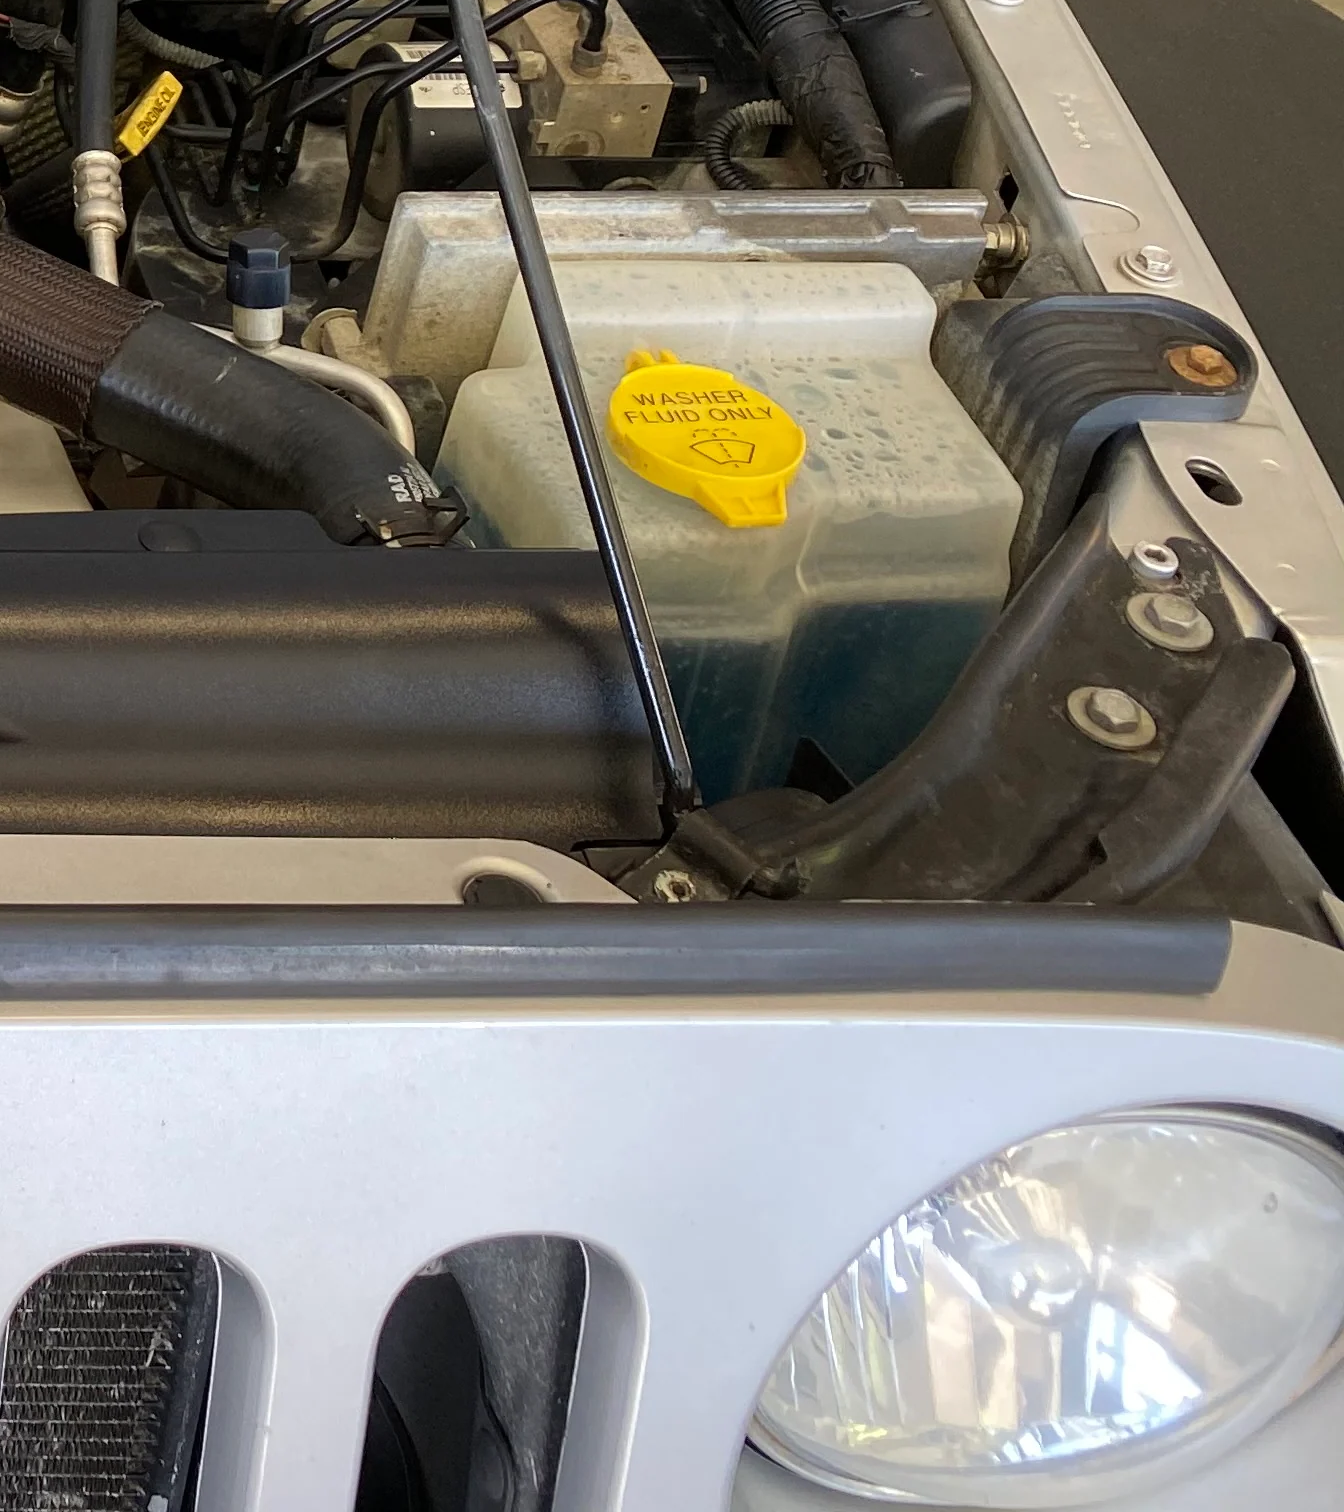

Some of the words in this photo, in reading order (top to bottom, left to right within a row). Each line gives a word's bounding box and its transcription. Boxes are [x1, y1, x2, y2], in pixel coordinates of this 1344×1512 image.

[136, 97, 167, 138] ENGINE
[632, 390, 748, 406] WASHER
[624, 407, 701, 424] FLUID
[709, 406, 774, 421] ONLY
[388, 474, 412, 502] RAD
